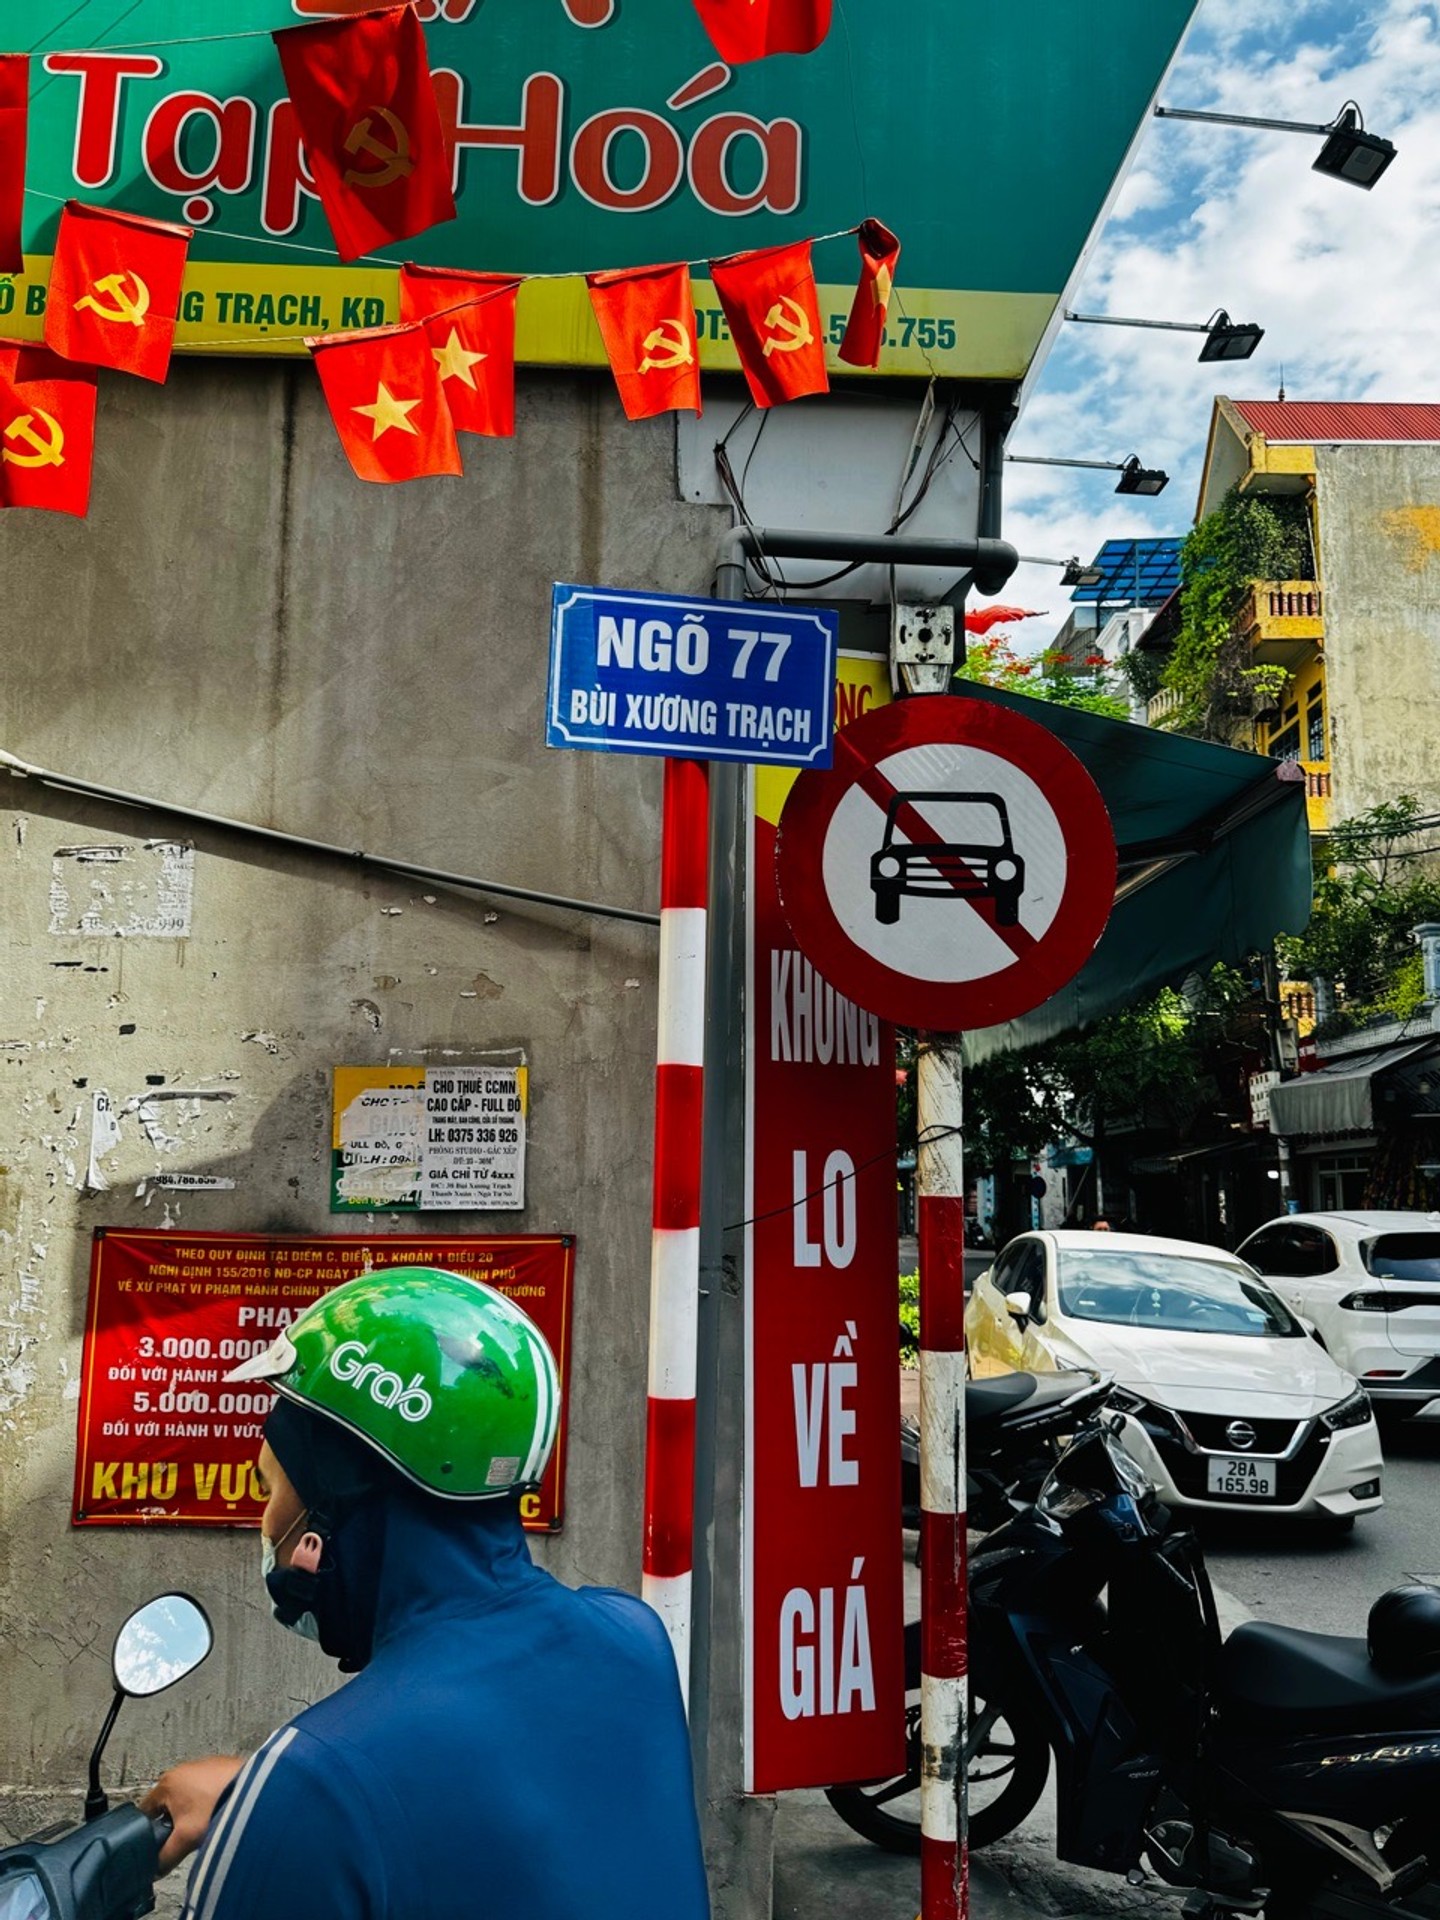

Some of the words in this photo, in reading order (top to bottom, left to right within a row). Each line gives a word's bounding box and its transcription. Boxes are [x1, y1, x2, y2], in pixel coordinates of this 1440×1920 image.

[428, 61, 803, 217] Hóa
[216, 292, 330, 332] TRẠCH,
[596, 613, 710, 675] NGÕ
[727, 628, 792, 683] 77
[569, 683, 617, 727] BÙI
[624, 692, 718, 736] XƯƠNG
[725, 702, 811, 748] TRẠCH
[433, 1080, 454, 1094] CHO
[485, 1080, 516, 1094] CCMN
[427, 1098, 448, 1112] CAO
[481, 1098, 504, 1112] FULL
[428, 1128, 445, 1142] LH:
[447, 1128, 474, 1142] 0375
[476, 1128, 496, 1142] 336
[498, 1128, 518, 1142] 926
[428, 1168, 448, 1179] GIÁ
[490, 1171, 515, 1179] 4xxx
[793, 1149, 856, 1269] LO
[175, 1248, 206, 1260] THEO
[208, 1249, 233, 1261] QUY
[236, 1250, 266, 1263] ĐỊNH
[270, 1251, 288, 1264] TẠI
[478, 1252, 494, 1263] 20
[216, 1267, 271, 1278] 155/2016
[155, 1282, 187, 1295] PHẠT
[190, 1283, 202, 1294] VI
[205, 1284, 241, 1297] PHẠM
[108, 1365, 136, 1381] ĐỐI
[141, 1367, 168, 1381] VỚI
[172, 1366, 218, 1382] HÀNH
[330, 1341, 432, 1422] Grab
[792, 1320, 859, 1488] VỀ
[103, 1418, 129, 1436] ĐỐI
[134, 1420, 160, 1436] VỚI
[165, 1422, 208, 1438] HÀNH
[213, 1424, 228, 1438] VI
[1228, 1461, 1257, 1477] 28A
[92, 1461, 178, 1500] KHU
[1216, 1476, 1269, 1494] 165.98
[779, 1556, 876, 1721] GIÁ
